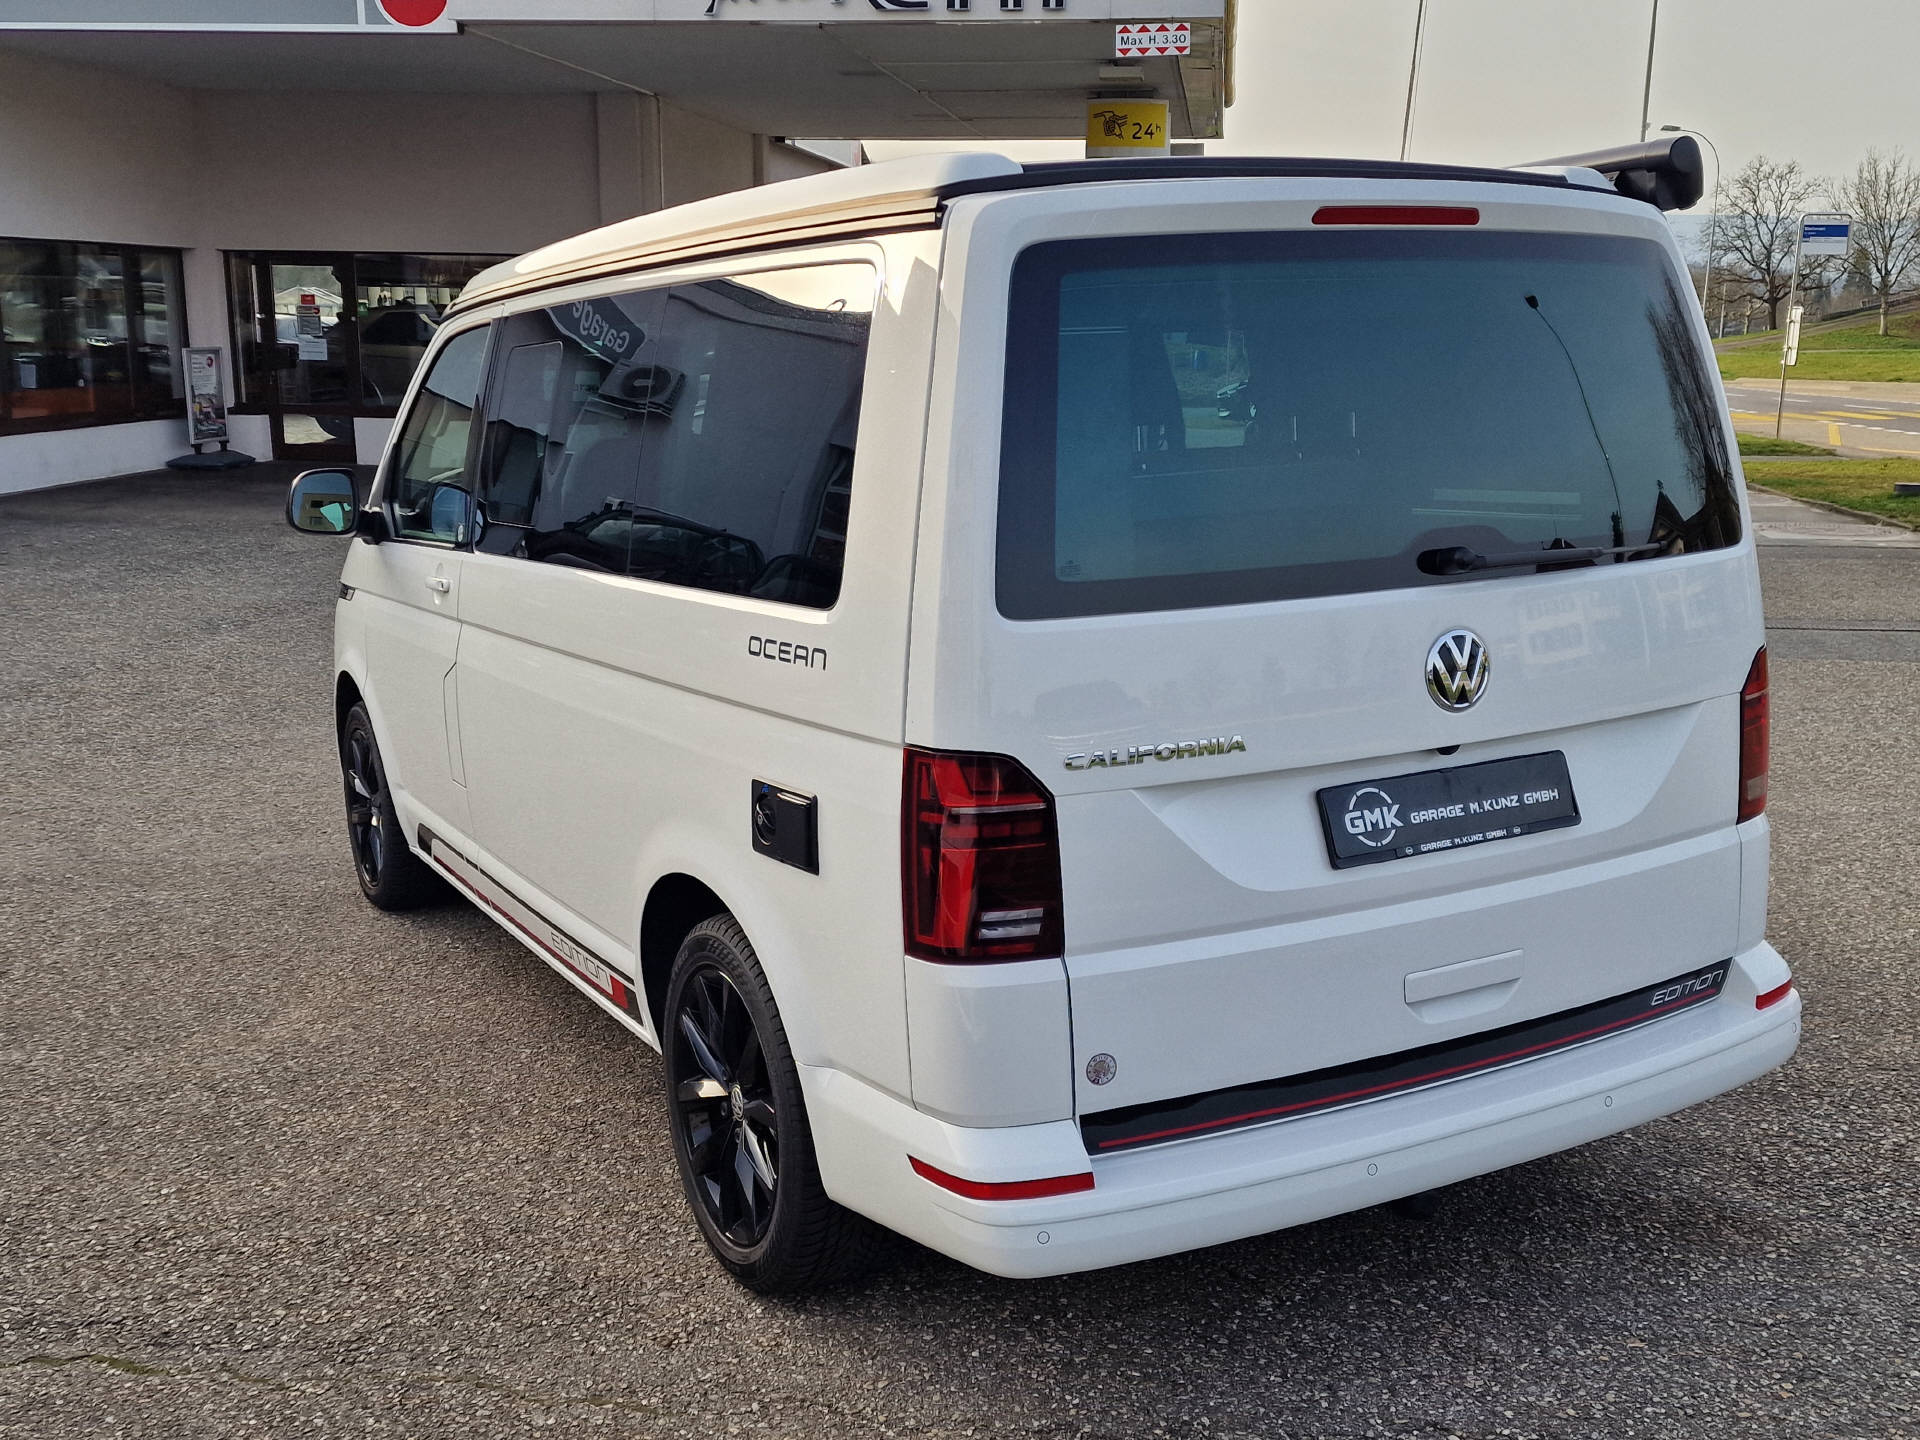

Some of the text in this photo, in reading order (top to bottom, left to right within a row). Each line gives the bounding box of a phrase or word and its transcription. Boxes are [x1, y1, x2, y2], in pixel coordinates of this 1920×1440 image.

[1120, 35, 1143, 46] Max
[1131, 122, 1162, 140] 24h
[748, 635, 827, 671] OCEAN
[1063, 733, 1247, 771] CALIFORNIA
[1344, 804, 1405, 834] GMK
[1410, 788, 1559, 824] GARAGE M.KUNZ GMBH
[1420, 839, 1453, 852] GARAGE
[1454, 833, 1484, 846] M.KUNZ
[1486, 828, 1508, 840] GMBH
[551, 931, 610, 987] EDITION
[1650, 969, 1724, 1006] EDITION
